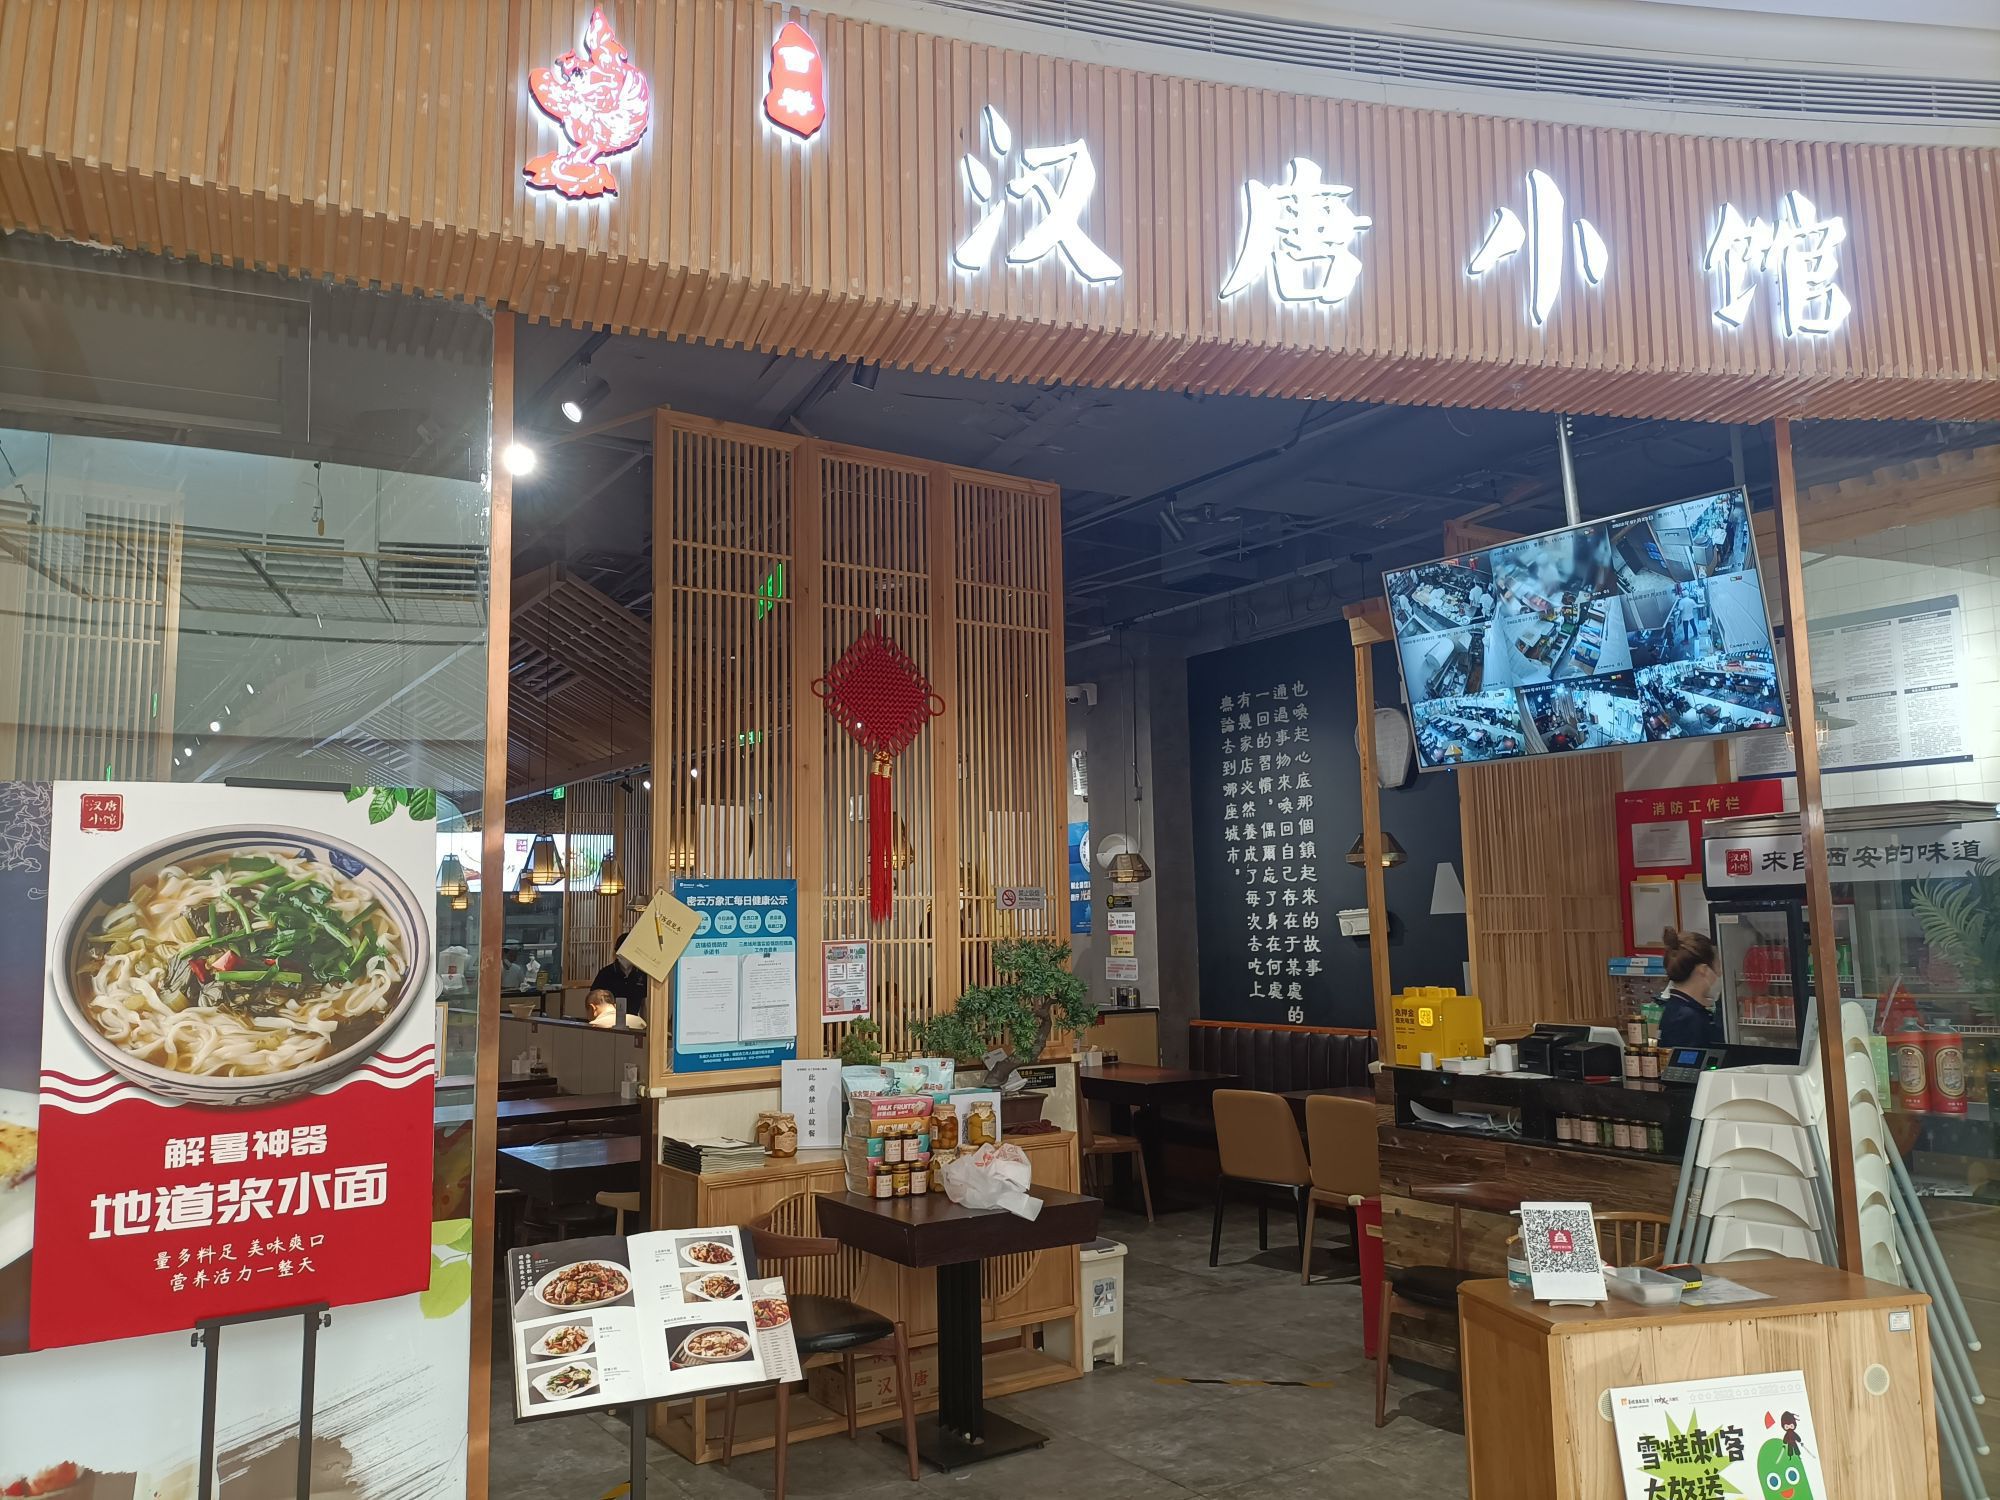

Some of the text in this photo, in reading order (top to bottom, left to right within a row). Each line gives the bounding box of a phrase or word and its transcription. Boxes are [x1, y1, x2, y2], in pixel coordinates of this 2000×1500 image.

[953, 104, 1851, 338] 汉唐小馆
[88, 799, 117, 812] 汉唐
[88, 813, 117, 825] 小馆
[1652, 796, 1741, 817] 消防工作栏
[1292, 680, 1323, 977] 也喚起心底那個鎖起來的故事
[1730, 852, 1749, 862] 汉唐
[686, 895, 789, 907] 密云万象汇每日健康公示
[808, 1073, 817, 1138] 此桌禁止就餐
[164, 1124, 327, 1169] 解暑神器
[89, 1162, 388, 1240] 地道浆水面
[153, 1233, 325, 1271] 量多料足 美味爽口
[169, 1256, 316, 1292] 营养活力一整天
[1637, 1425, 1744, 1470] 雪糕刺客
[1644, 1468, 1725, 1500] 大放送
